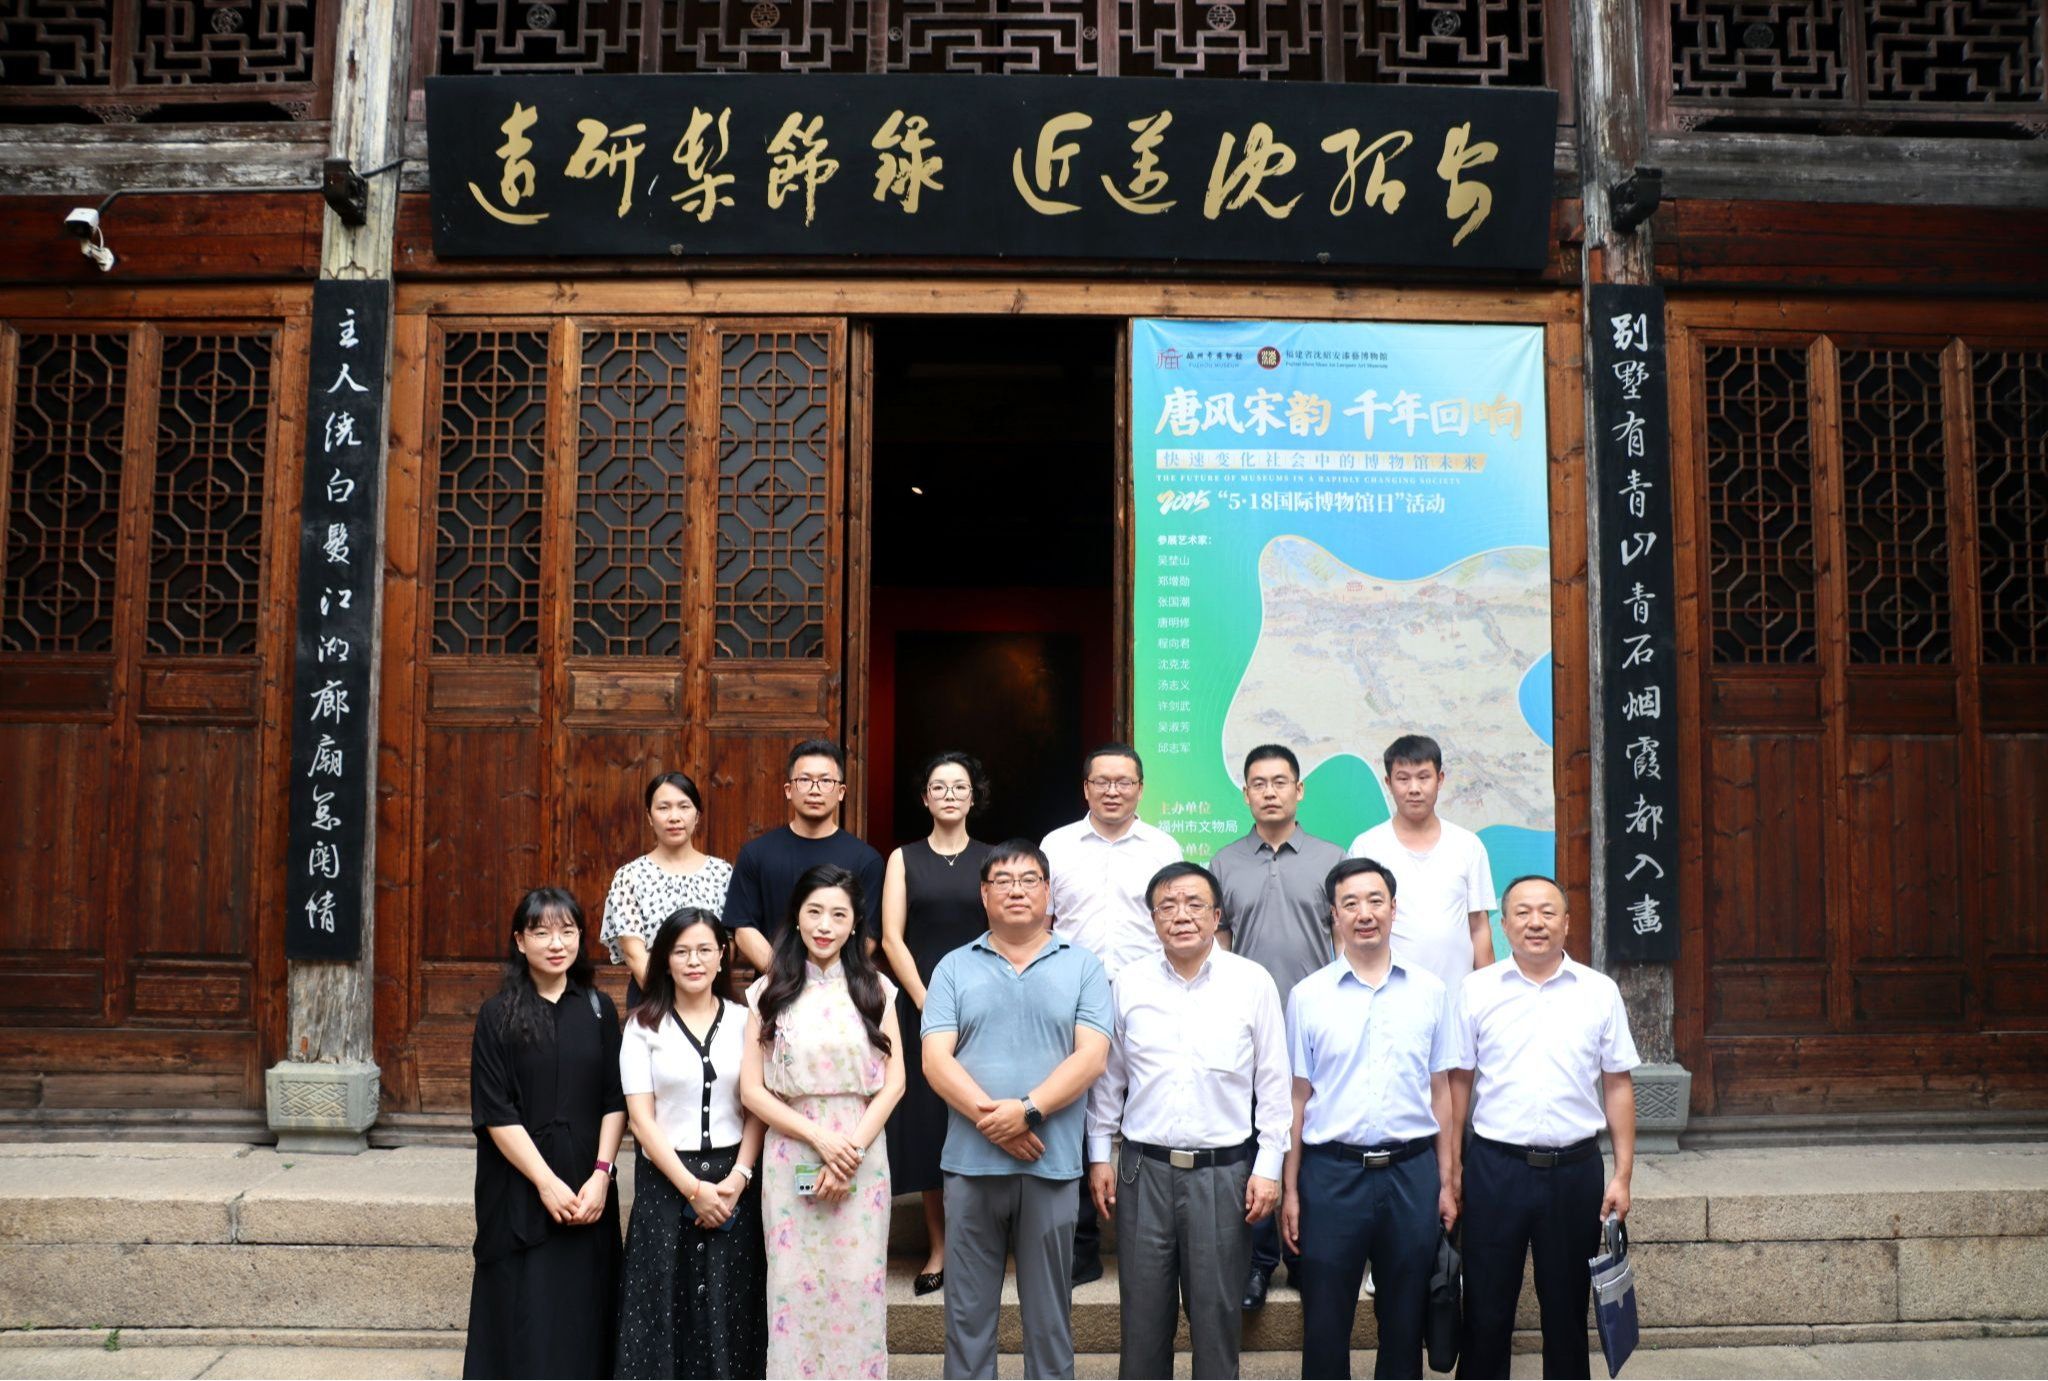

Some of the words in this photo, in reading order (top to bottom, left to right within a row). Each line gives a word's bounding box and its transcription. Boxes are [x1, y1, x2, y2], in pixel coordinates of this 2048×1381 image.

[1155, 387, 1332, 437] 唐风宋韵
[1343, 389, 1523, 441] 千年回响
[1164, 452, 1478, 471] 快速变化社会中的博物馆未来
[1241, 475, 1289, 483] MUSEUMS
[1293, 475, 1304, 483] IN
[1318, 476, 1360, 484] RAPIDLY
[1420, 477, 1462, 485] SOCIETY
[1156, 489, 1212, 516] 2025
[1158, 820, 1238, 833] 福州市文物局
[1183, 843, 1211, 856] 单位
